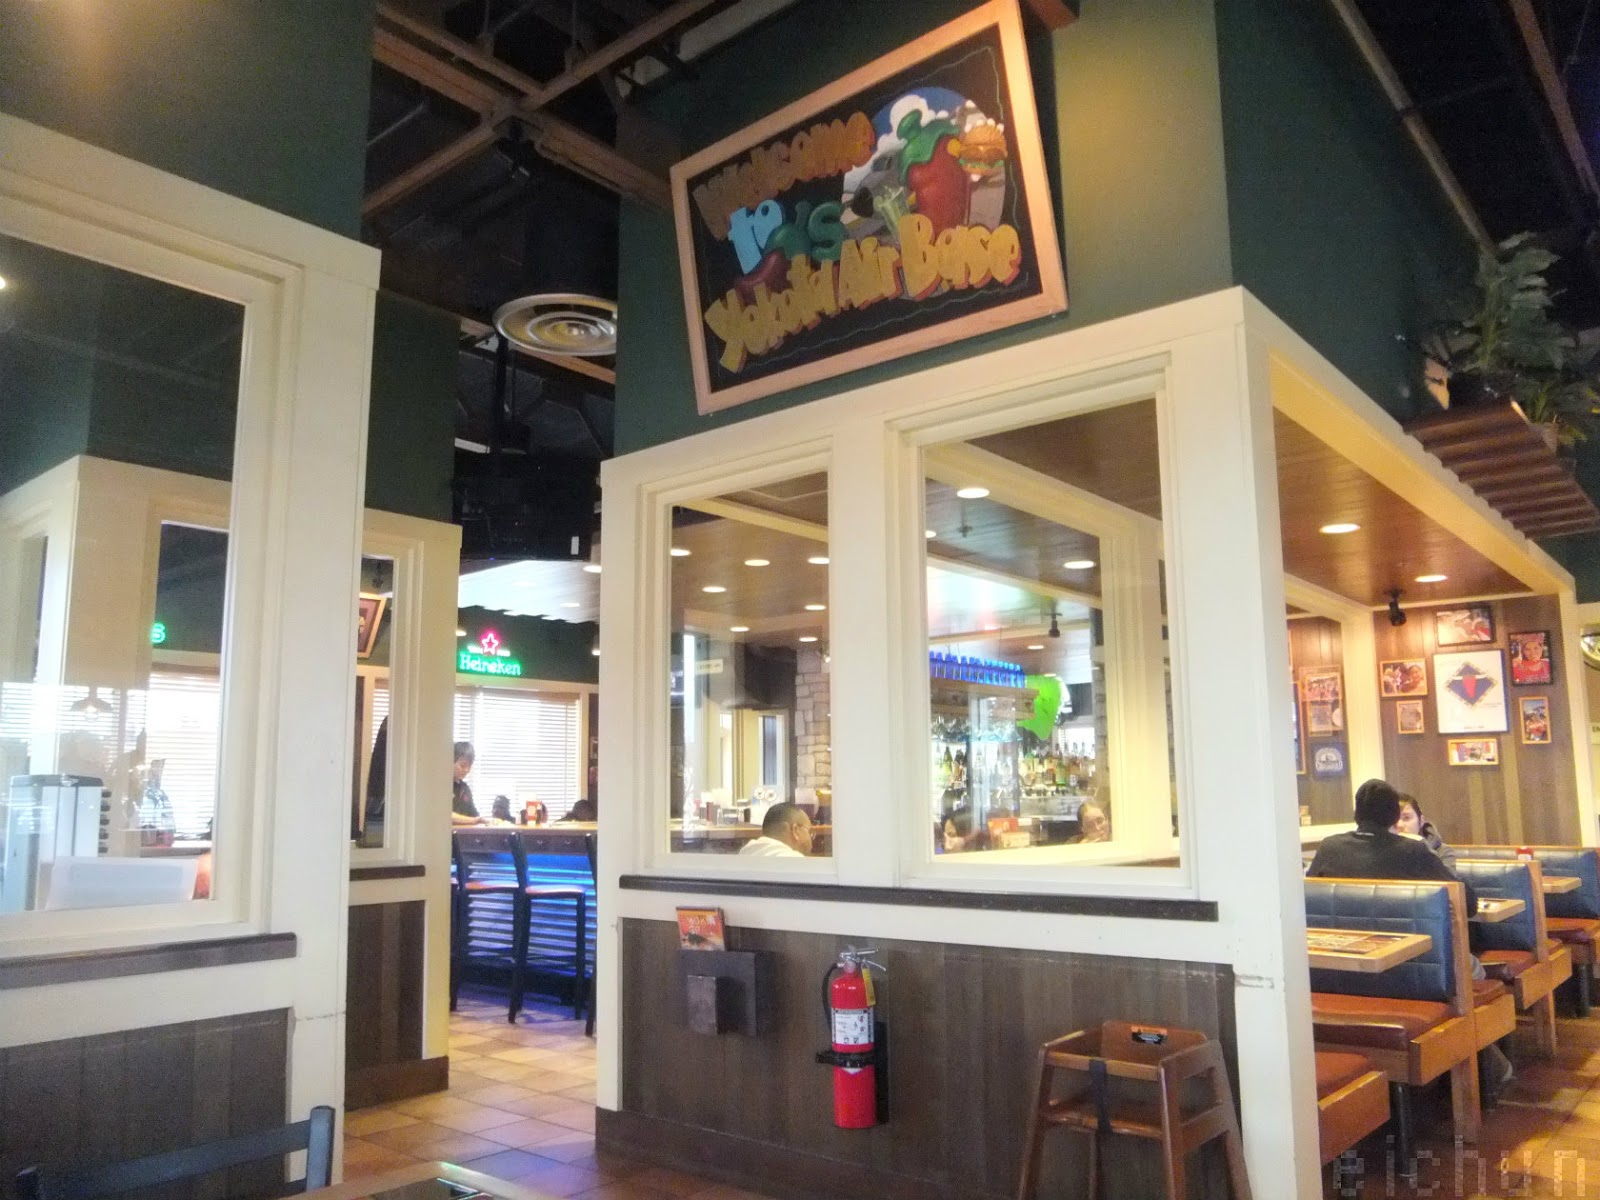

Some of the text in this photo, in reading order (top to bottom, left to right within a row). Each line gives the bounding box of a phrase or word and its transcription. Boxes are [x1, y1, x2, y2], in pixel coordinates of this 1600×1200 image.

[704, 213, 1022, 374] Yokota Air Base
[459, 652, 522, 676] Heineken
